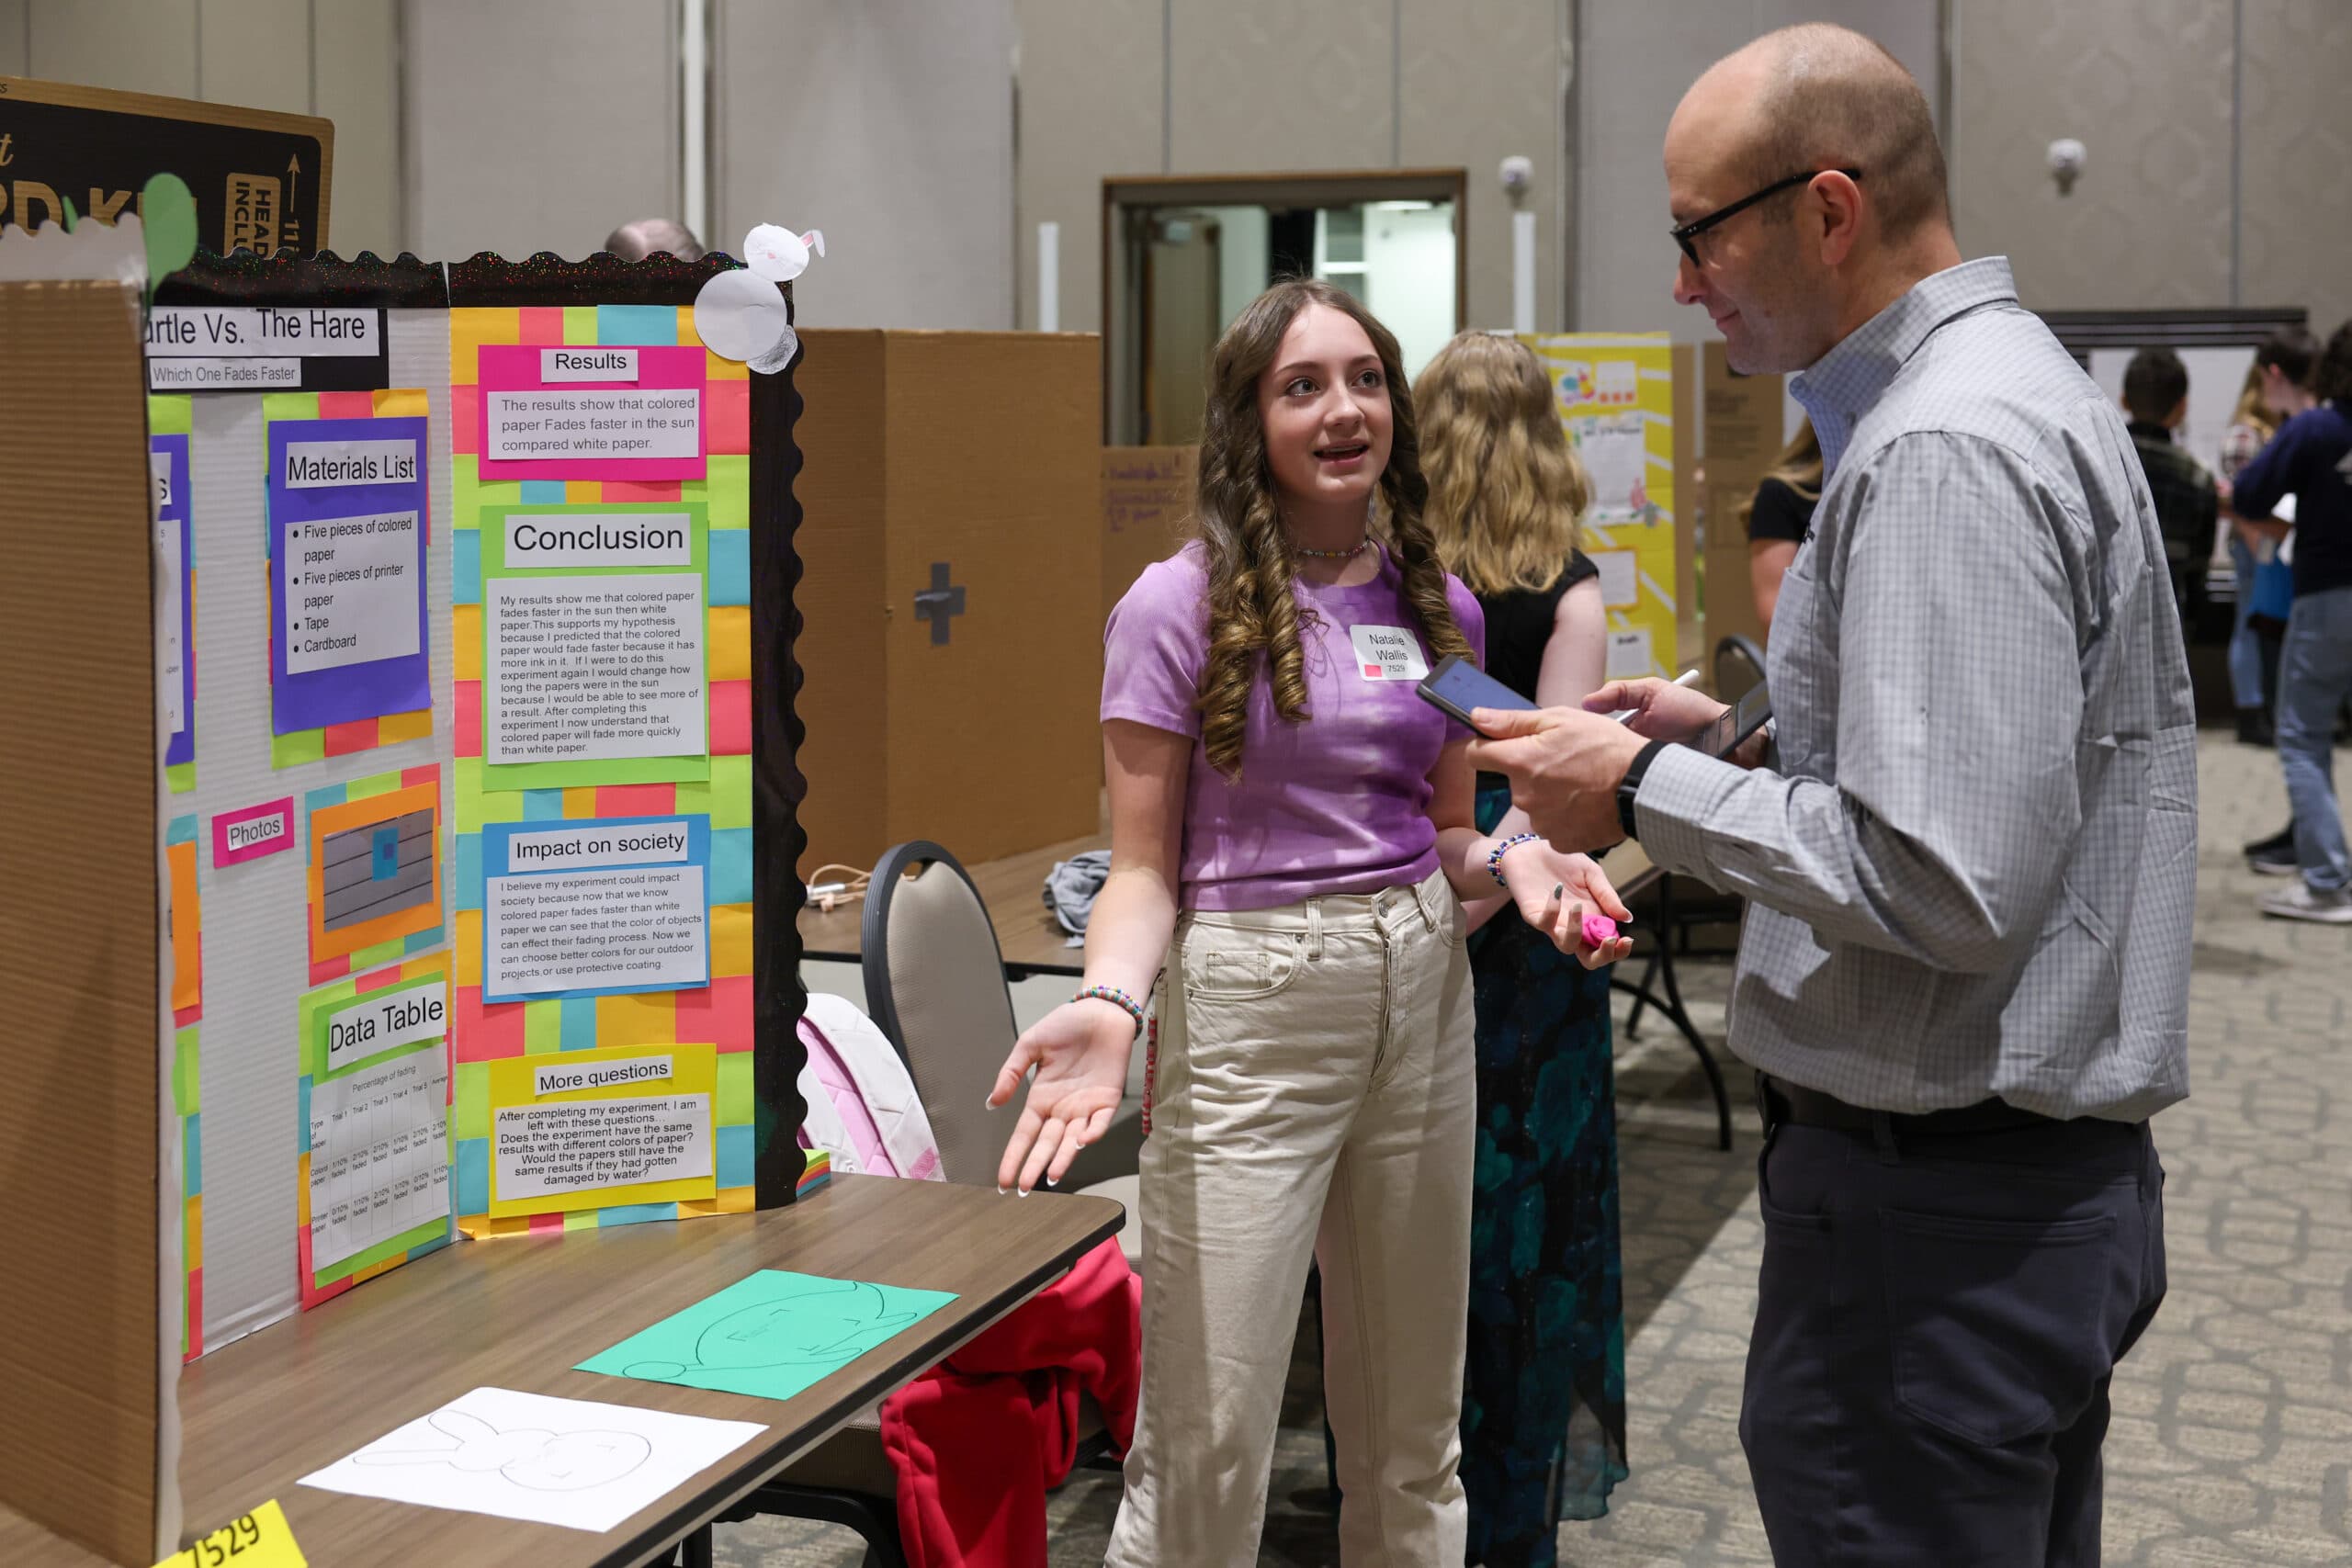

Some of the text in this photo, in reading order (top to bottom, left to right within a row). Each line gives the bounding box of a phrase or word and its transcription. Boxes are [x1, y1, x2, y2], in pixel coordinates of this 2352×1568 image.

[204, 313, 244, 344] Vs.
[255, 308, 301, 338] The
[311, 309, 365, 339] Hare
[556, 353, 627, 369] Results
[153, 367, 295, 381] Which One Fades Faster
[502, 397, 695, 412] The results show that colored
[503, 417, 695, 434] paper Fades faster in the sun
[503, 438, 651, 452] compared white paper.
[288, 456, 413, 480] Materials List
[304, 517, 412, 539] Five pieces of colored
[514, 524, 683, 550] Conclusion
[304, 549, 335, 566] paper
[304, 564, 403, 585] Five pieces of printer
[304, 595, 334, 610] paper
[501, 596, 516, 607] My
[519, 595, 553, 604] results
[556, 595, 582, 604] show
[605, 593, 624, 603] that
[626, 592, 662, 602] colored
[666, 593, 695, 603] paper
[500, 608, 529, 617] fades
[532, 607, 560, 616] faster
[564, 607, 572, 615] in
[575, 607, 592, 615] the
[616, 606, 638, 615] then
[640, 604, 667, 614] white
[304, 617, 329, 632] Tape
[501, 616, 675, 632] paper.This supports my hypothesis
[304, 633, 356, 652] Cardboard
[501, 631, 544, 643] because
[553, 631, 600, 643] predicted
[603, 630, 622, 639] that
[625, 630, 641, 638] the
[643, 628, 680, 638] colored
[1369, 634, 1405, 646] Natalie
[501, 640, 695, 657] paper would fade faster because it has
[1376, 650, 1408, 660] Wallis
[501, 656, 527, 668] more
[530, 658, 545, 667] ink
[548, 658, 557, 666] in
[575, 656, 582, 665] If
[591, 657, 616, 665] were
[618, 656, 628, 664] to
[630, 655, 644, 663] do
[646, 654, 664, 663] this
[230, 819, 280, 845] Photos
[517, 833, 684, 861] Impact on society
[507, 882, 542, 891] believe
[545, 882, 560, 890] my
[562, 877, 616, 889] experiment
[618, 874, 645, 886] could
[648, 873, 680, 884] impact
[500, 897, 535, 907] society
[538, 895, 580, 904] because
[605, 891, 623, 899] that
[501, 902, 680, 920] colored paper fades faster than white
[331, 997, 443, 1053] Data Table
[353, 1066, 416, 1093] Percentage of fading
[540, 1064, 668, 1090] More questions
[499, 1111, 526, 1122] After
[528, 1108, 586, 1120] completing
[590, 1108, 605, 1116] my
[609, 1102, 670, 1115] experiment,
[527, 1121, 544, 1131] left
[547, 1118, 568, 1129] with
[571, 1115, 603, 1127] these
[501, 1123, 692, 1143] Does the experiment have the same
[499, 1132, 694, 1154] results with different colors of paper?
[181, 1513, 261, 1568] 7529
